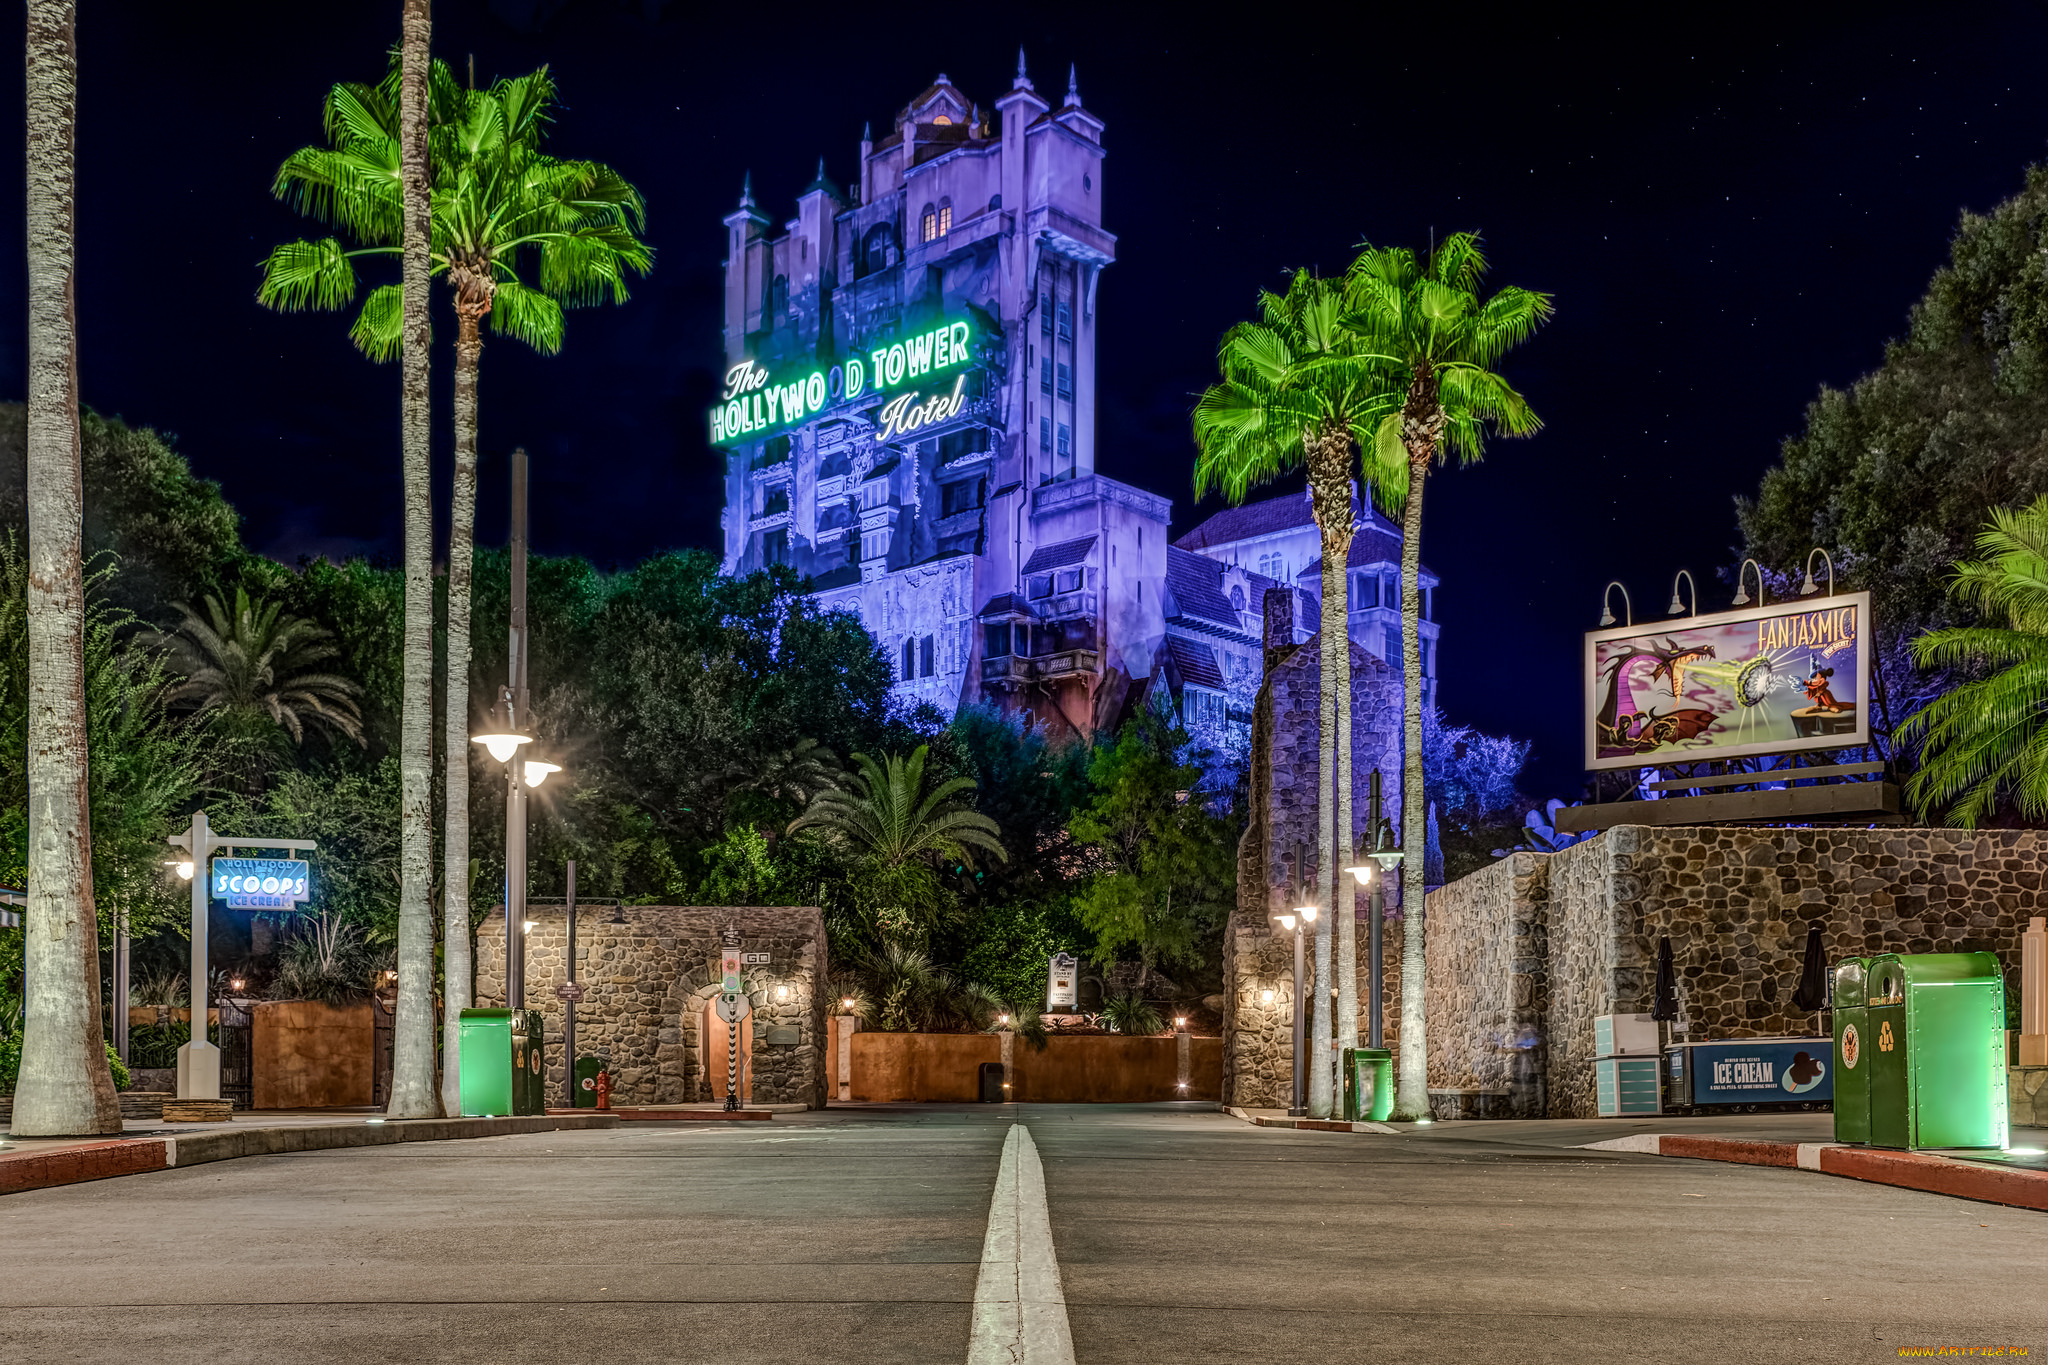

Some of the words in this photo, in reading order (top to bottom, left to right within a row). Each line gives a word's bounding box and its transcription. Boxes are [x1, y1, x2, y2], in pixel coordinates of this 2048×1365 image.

[872, 321, 970, 389] TOWER
[723, 359, 769, 400] The
[875, 374, 967, 442] Hotel
[1758, 607, 1856, 651] FANTASMIC!
[227, 860, 293, 870] HOLLYWOOD
[217, 875, 306, 895] SCOOPS
[230, 896, 247, 906] ICE
[747, 954, 769, 963] GO
[1713, 1061, 1732, 1084] ICE
[1734, 1062, 1773, 1083] CREAM
